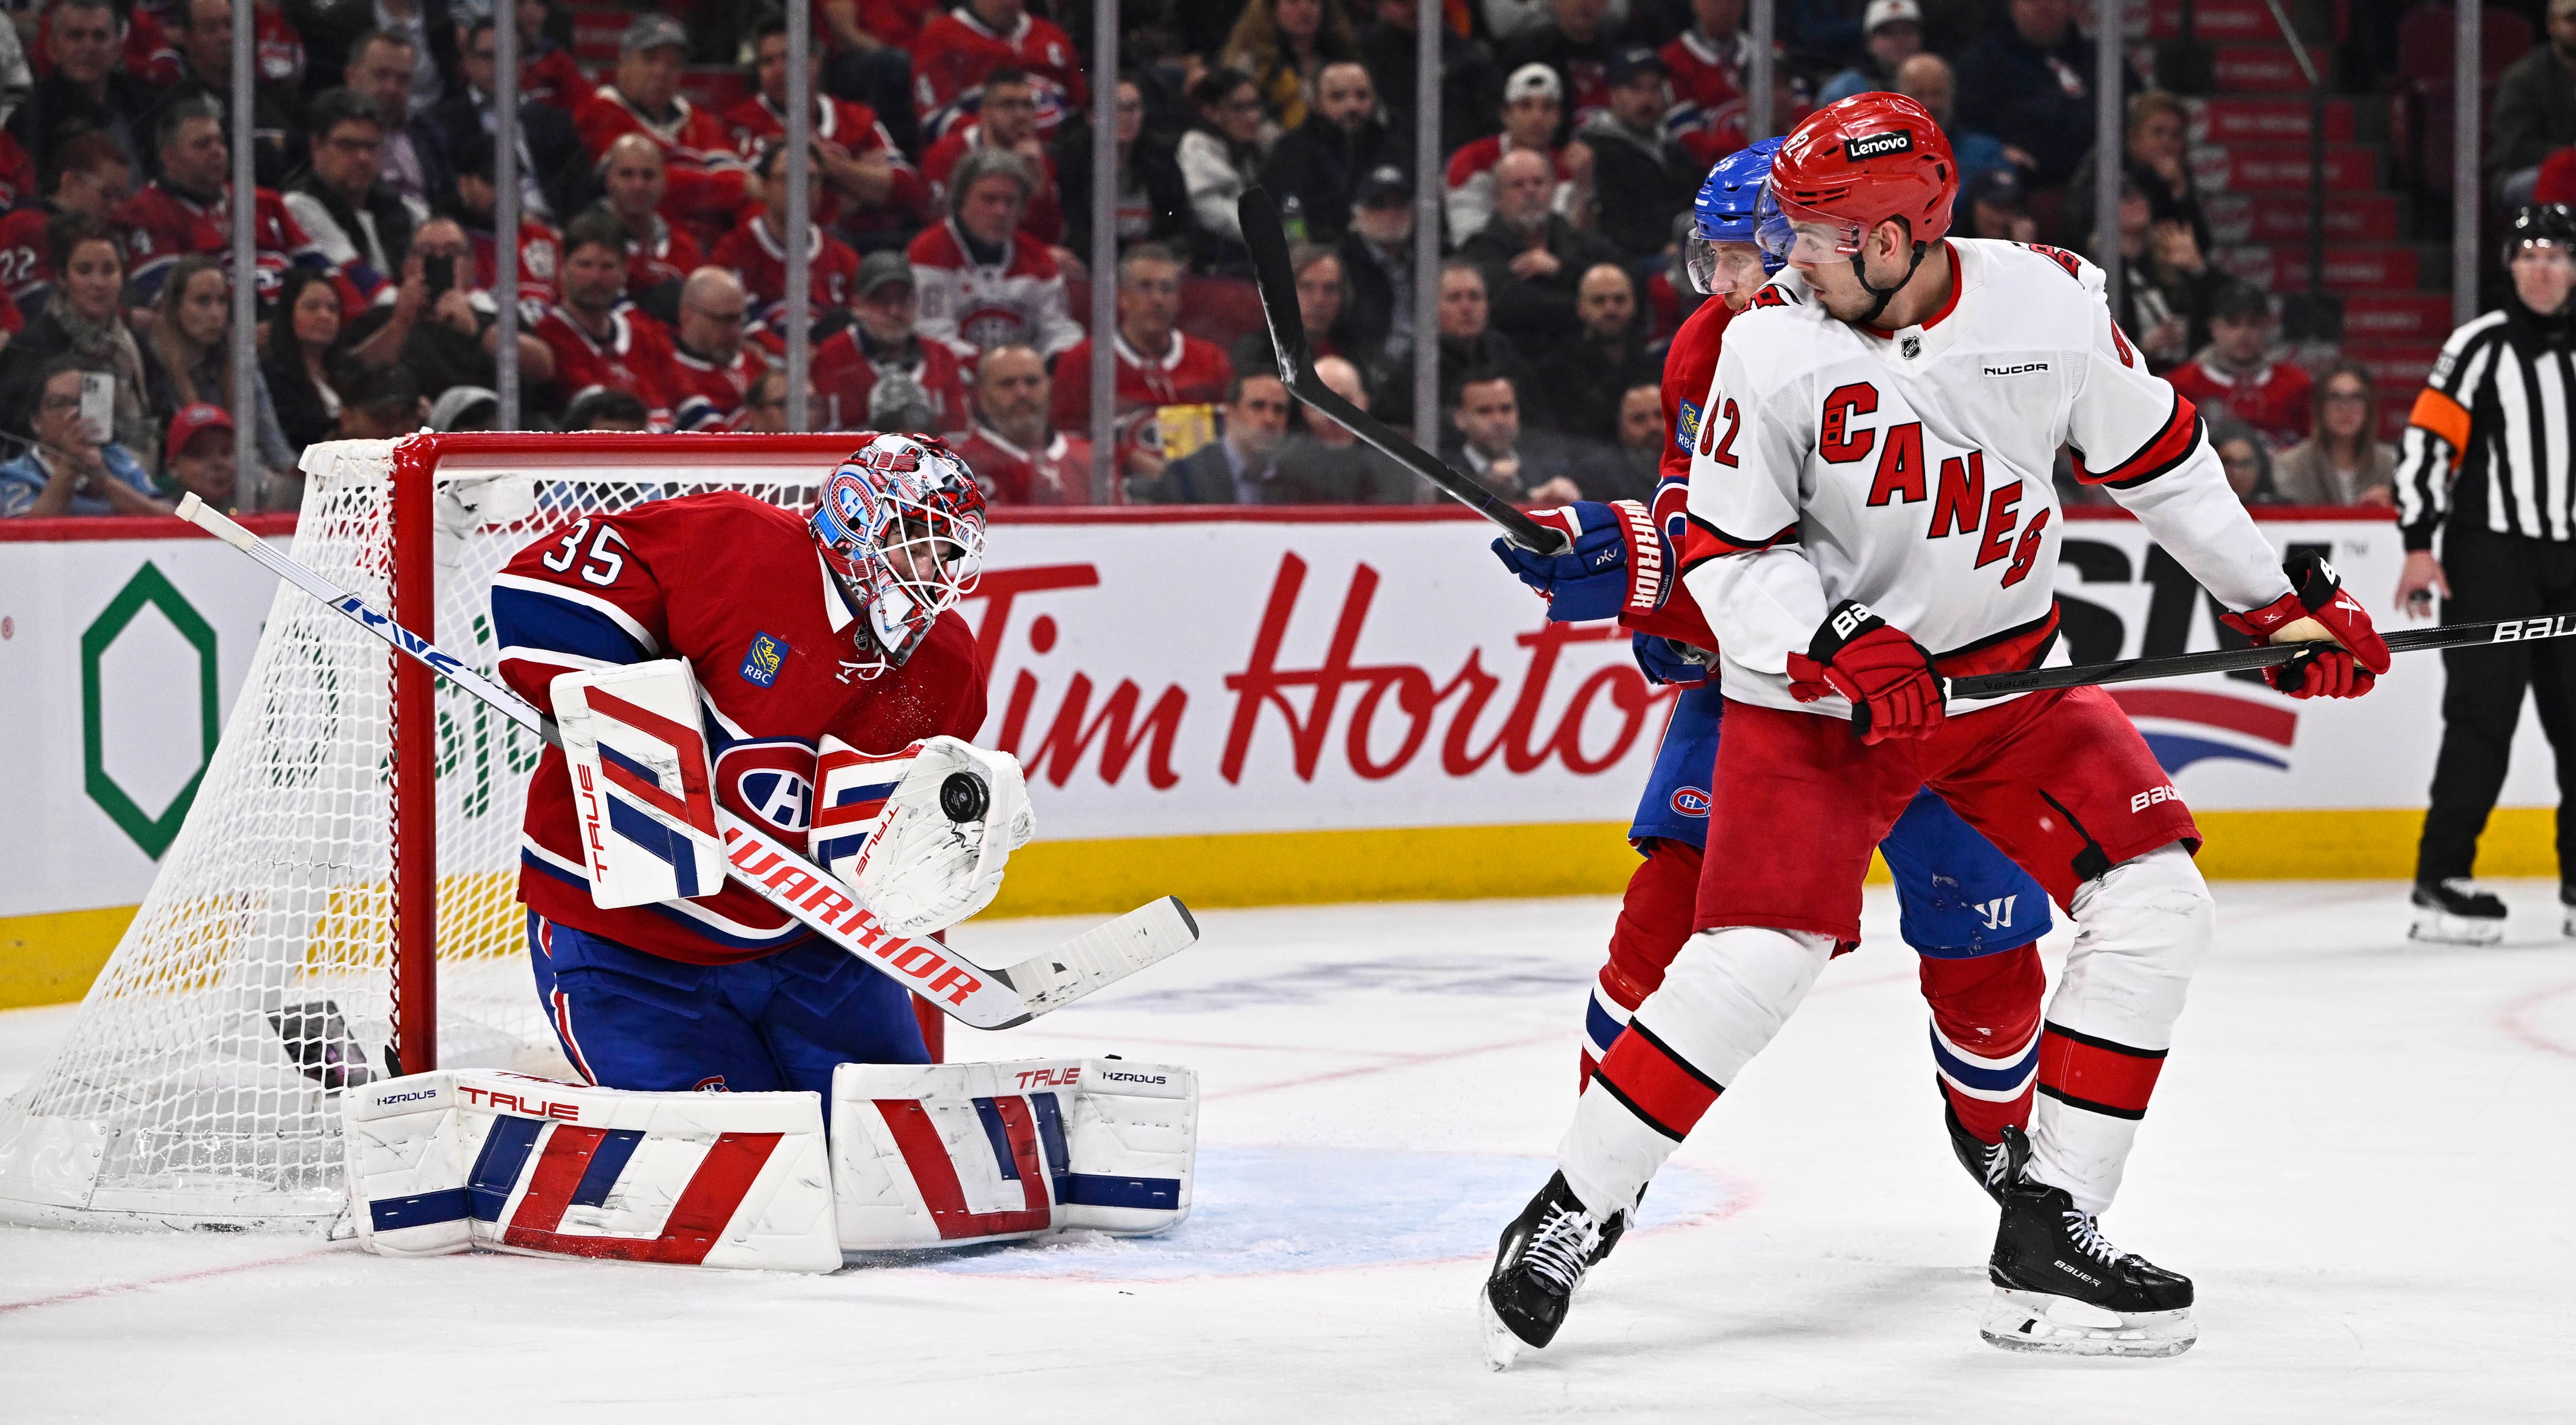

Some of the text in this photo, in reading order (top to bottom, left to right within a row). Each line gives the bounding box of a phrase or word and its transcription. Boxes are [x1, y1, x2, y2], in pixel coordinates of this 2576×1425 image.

[1850, 135, 1907, 157] Lenovo
[1905, 342, 1918, 357] NHL
[1984, 363, 2048, 375] NUCOR
[1678, 433, 1696, 453] RBC
[1819, 381, 2050, 590] CANES
[542, 517, 631, 587] 35
[1611, 499, 1662, 608] WARRIOR
[744, 664, 771, 684] RBC
[942, 549, 1677, 789] Tim Horto
[577, 763, 608, 884] TRUE
[855, 806, 900, 878] TRUE
[724, 827, 982, 1007] WARRIOR
[377, 1085, 580, 1122] HZRDUS TRUE
[1015, 1067, 1166, 1090] TRUE HZRDUS
